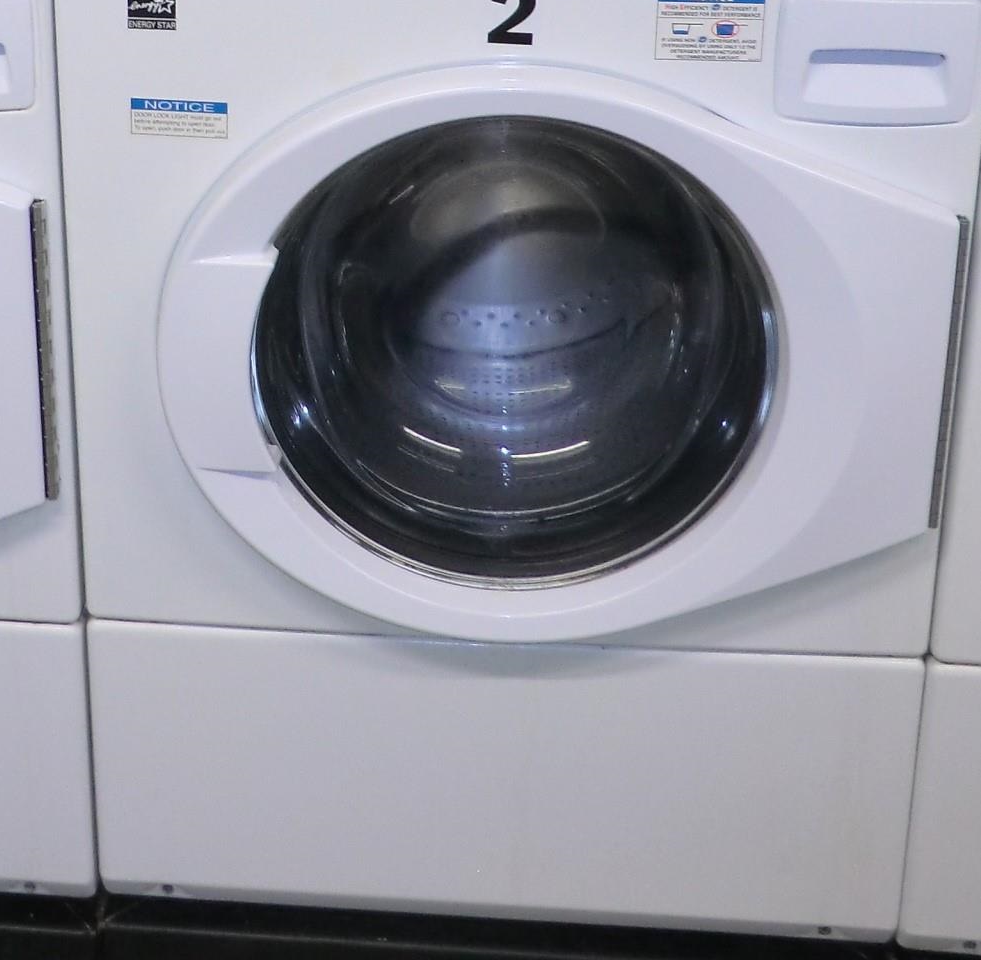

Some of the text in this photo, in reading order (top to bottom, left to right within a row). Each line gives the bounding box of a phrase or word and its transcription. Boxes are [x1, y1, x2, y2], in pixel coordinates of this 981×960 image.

[128, 20, 176, 30] ENERGY STAR
[144, 100, 215, 112] NOTICE
